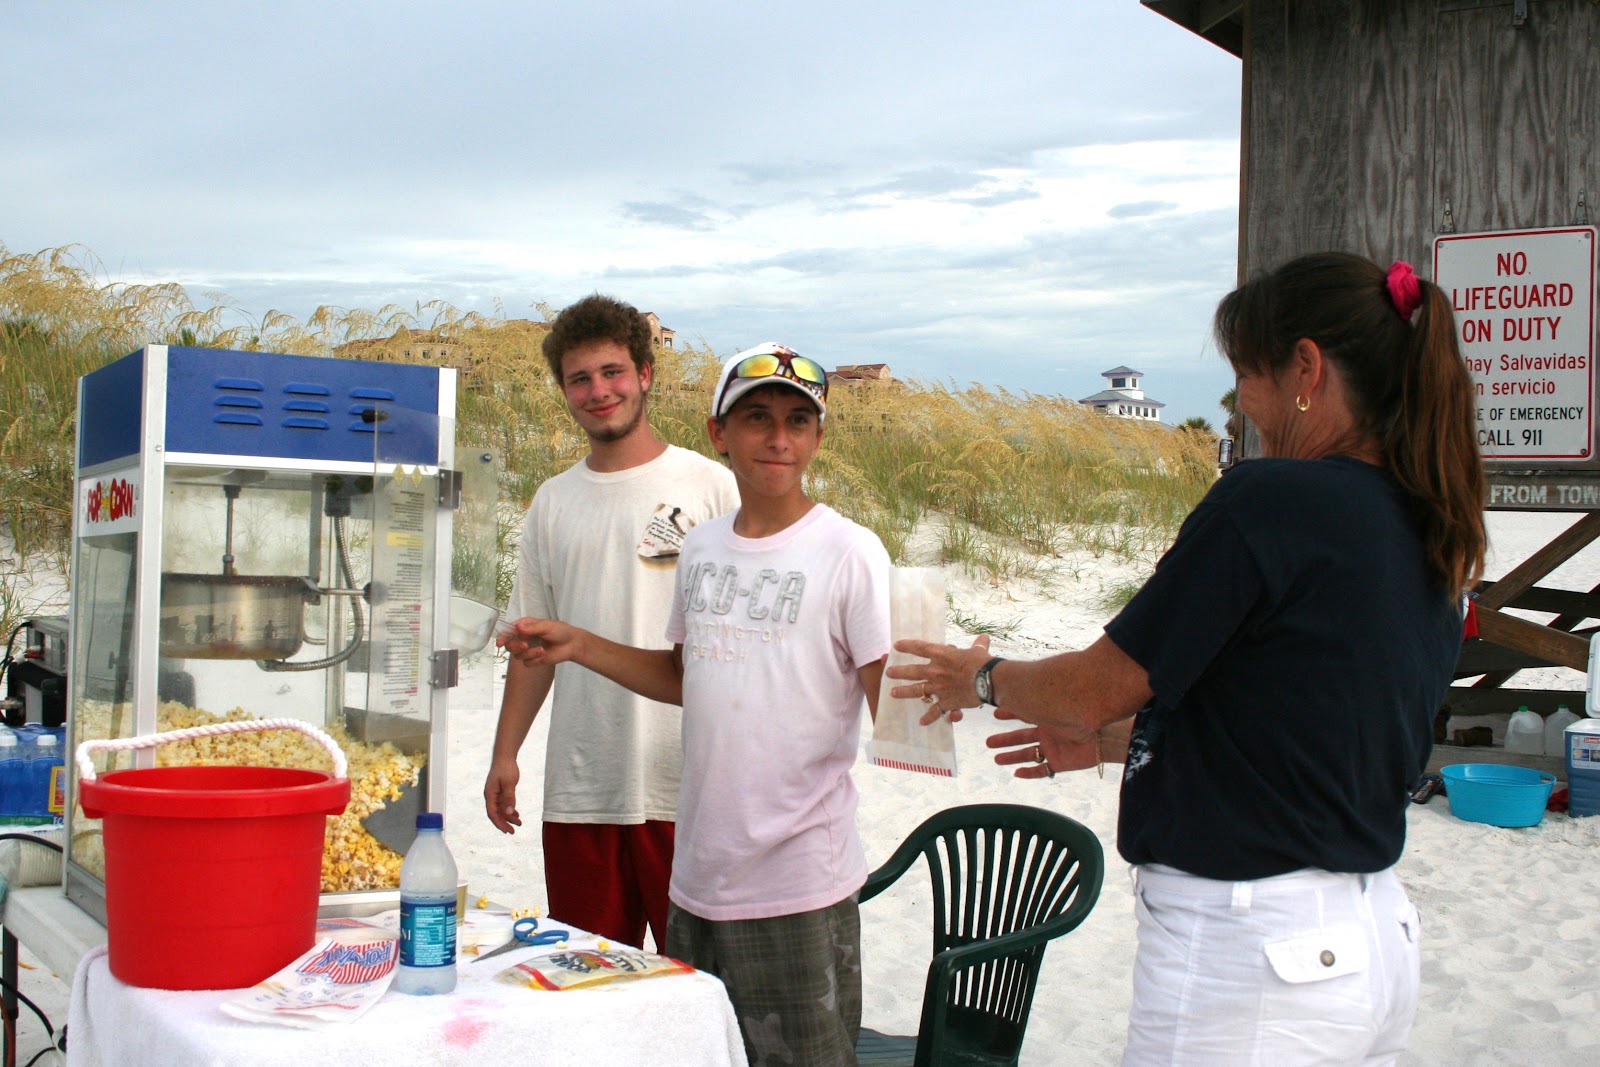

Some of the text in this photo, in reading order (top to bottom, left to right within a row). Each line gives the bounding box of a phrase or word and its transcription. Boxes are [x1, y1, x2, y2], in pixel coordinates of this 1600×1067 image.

[1496, 251, 1528, 277] NO
[1452, 283, 1574, 311] LIFEGUARD
[1462, 316, 1562, 344] ON DUTY
[1465, 353, 1587, 376] hay Salvavidas
[1475, 378, 1556, 396] n servicio
[1490, 408, 1505, 421] OF
[1510, 406, 1584, 421] EMERGENCY
[1477, 429, 1542, 446] CALL 911
[1490, 484, 1600, 505] FROM TOW
